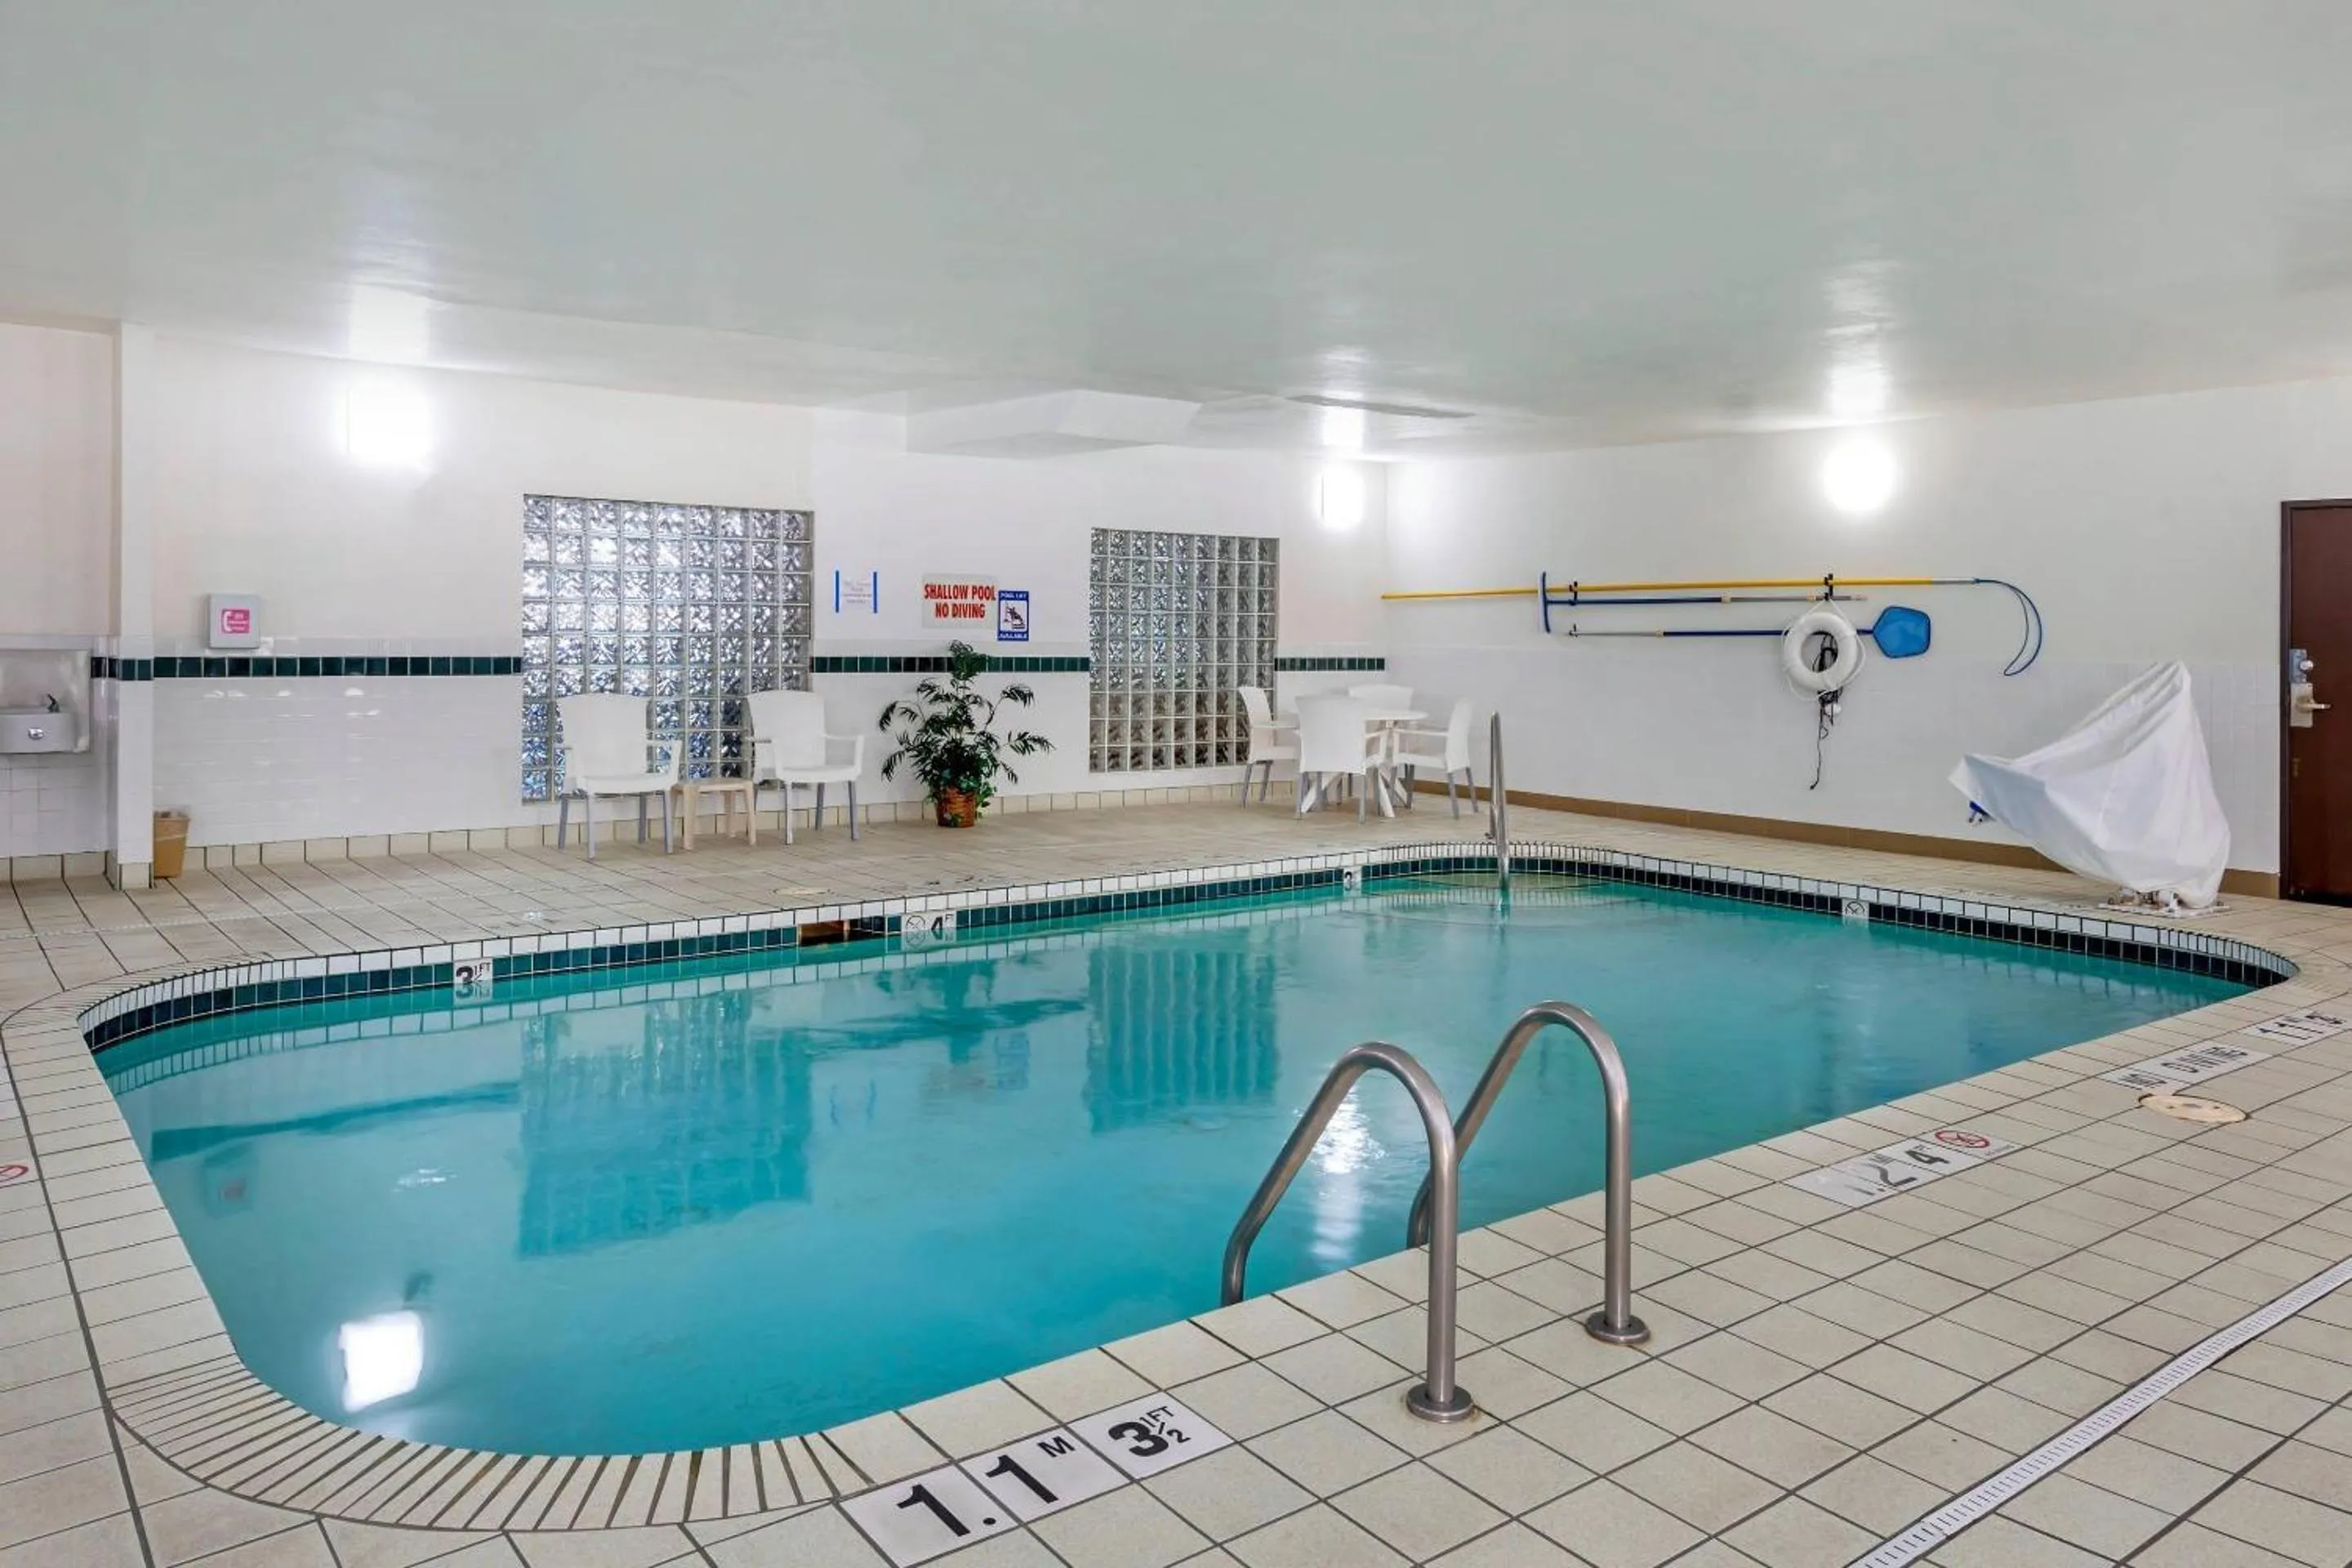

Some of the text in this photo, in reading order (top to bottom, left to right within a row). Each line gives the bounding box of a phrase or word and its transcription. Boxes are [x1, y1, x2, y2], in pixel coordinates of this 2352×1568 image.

[924, 583, 996, 601] SHALLOW POOL
[935, 603, 986, 618] NO DIVING
[1904, 1149, 1952, 1165] 4
[896, 1454, 1058, 1538] 1.1
[1036, 1436, 1076, 1459] M
[1146, 1405, 1174, 1422] FT
